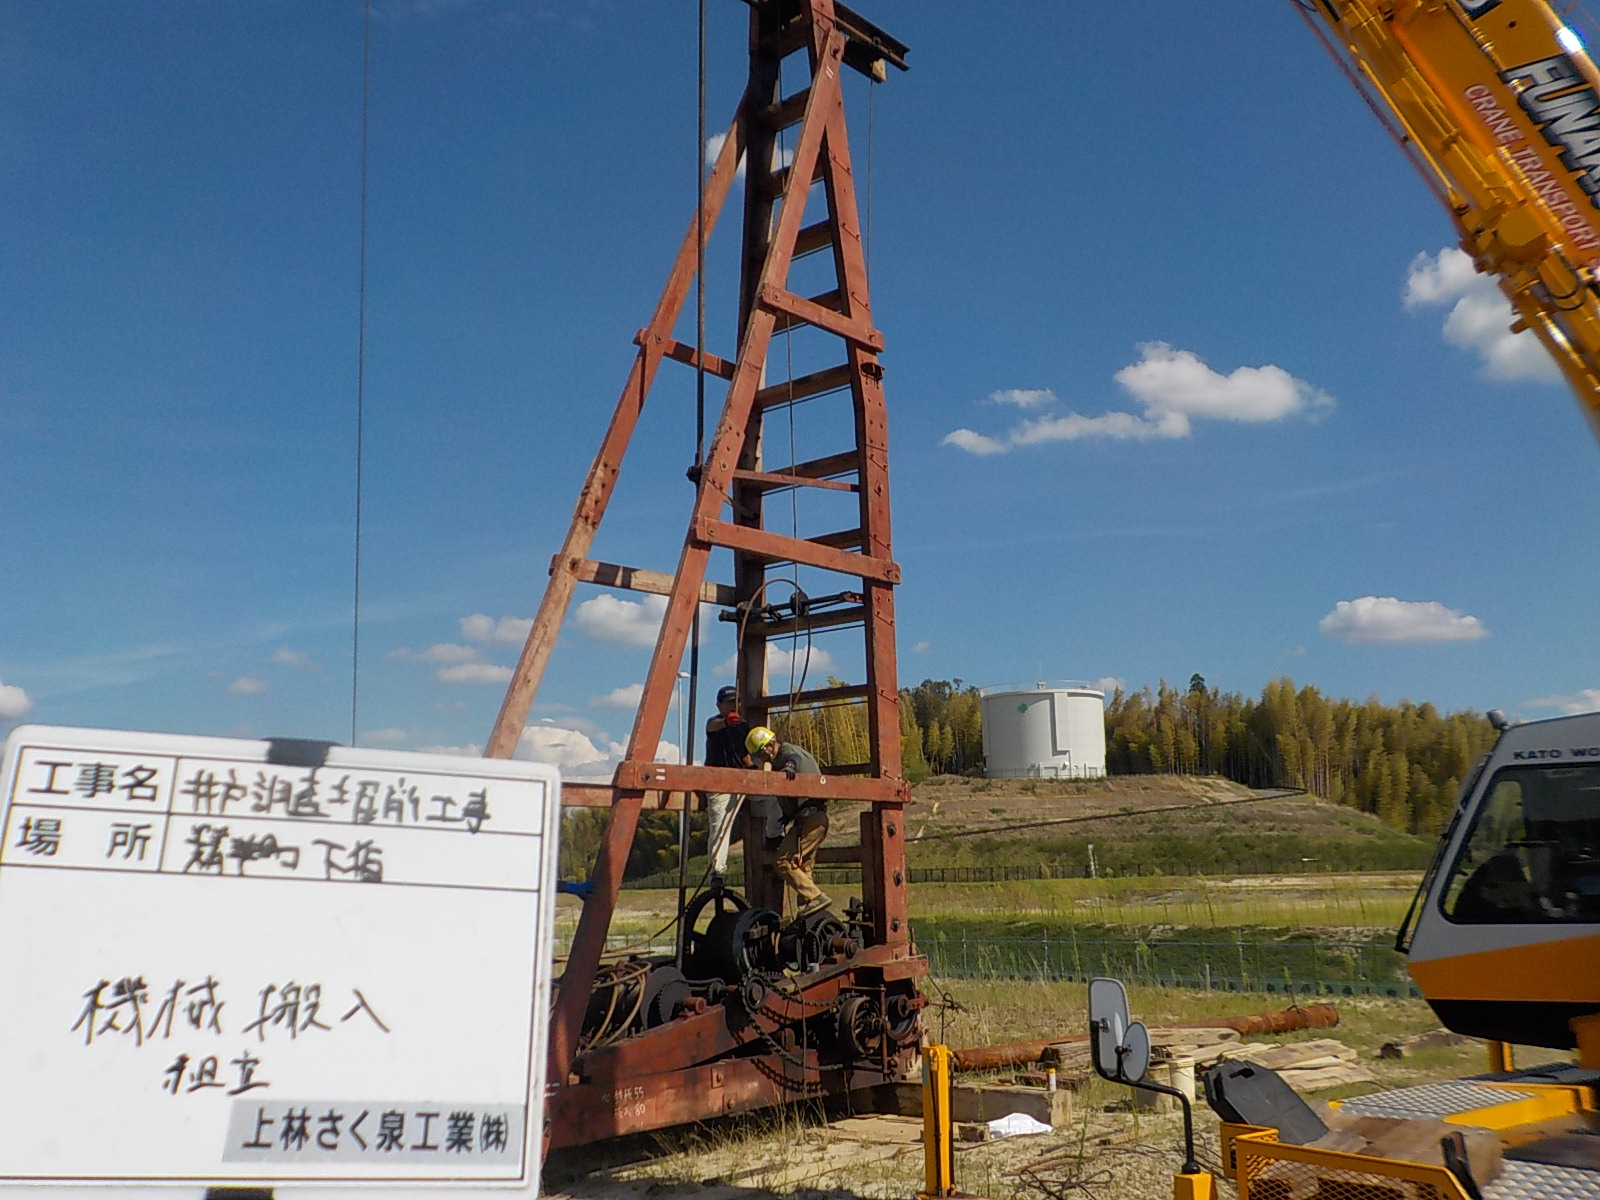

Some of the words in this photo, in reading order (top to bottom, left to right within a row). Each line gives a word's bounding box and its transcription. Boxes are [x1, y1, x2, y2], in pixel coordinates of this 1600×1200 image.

[1513, 748, 1562, 760] KATO
[27, 759, 159, 802] 工事名
[161, 1050, 271, 1096] 組立
